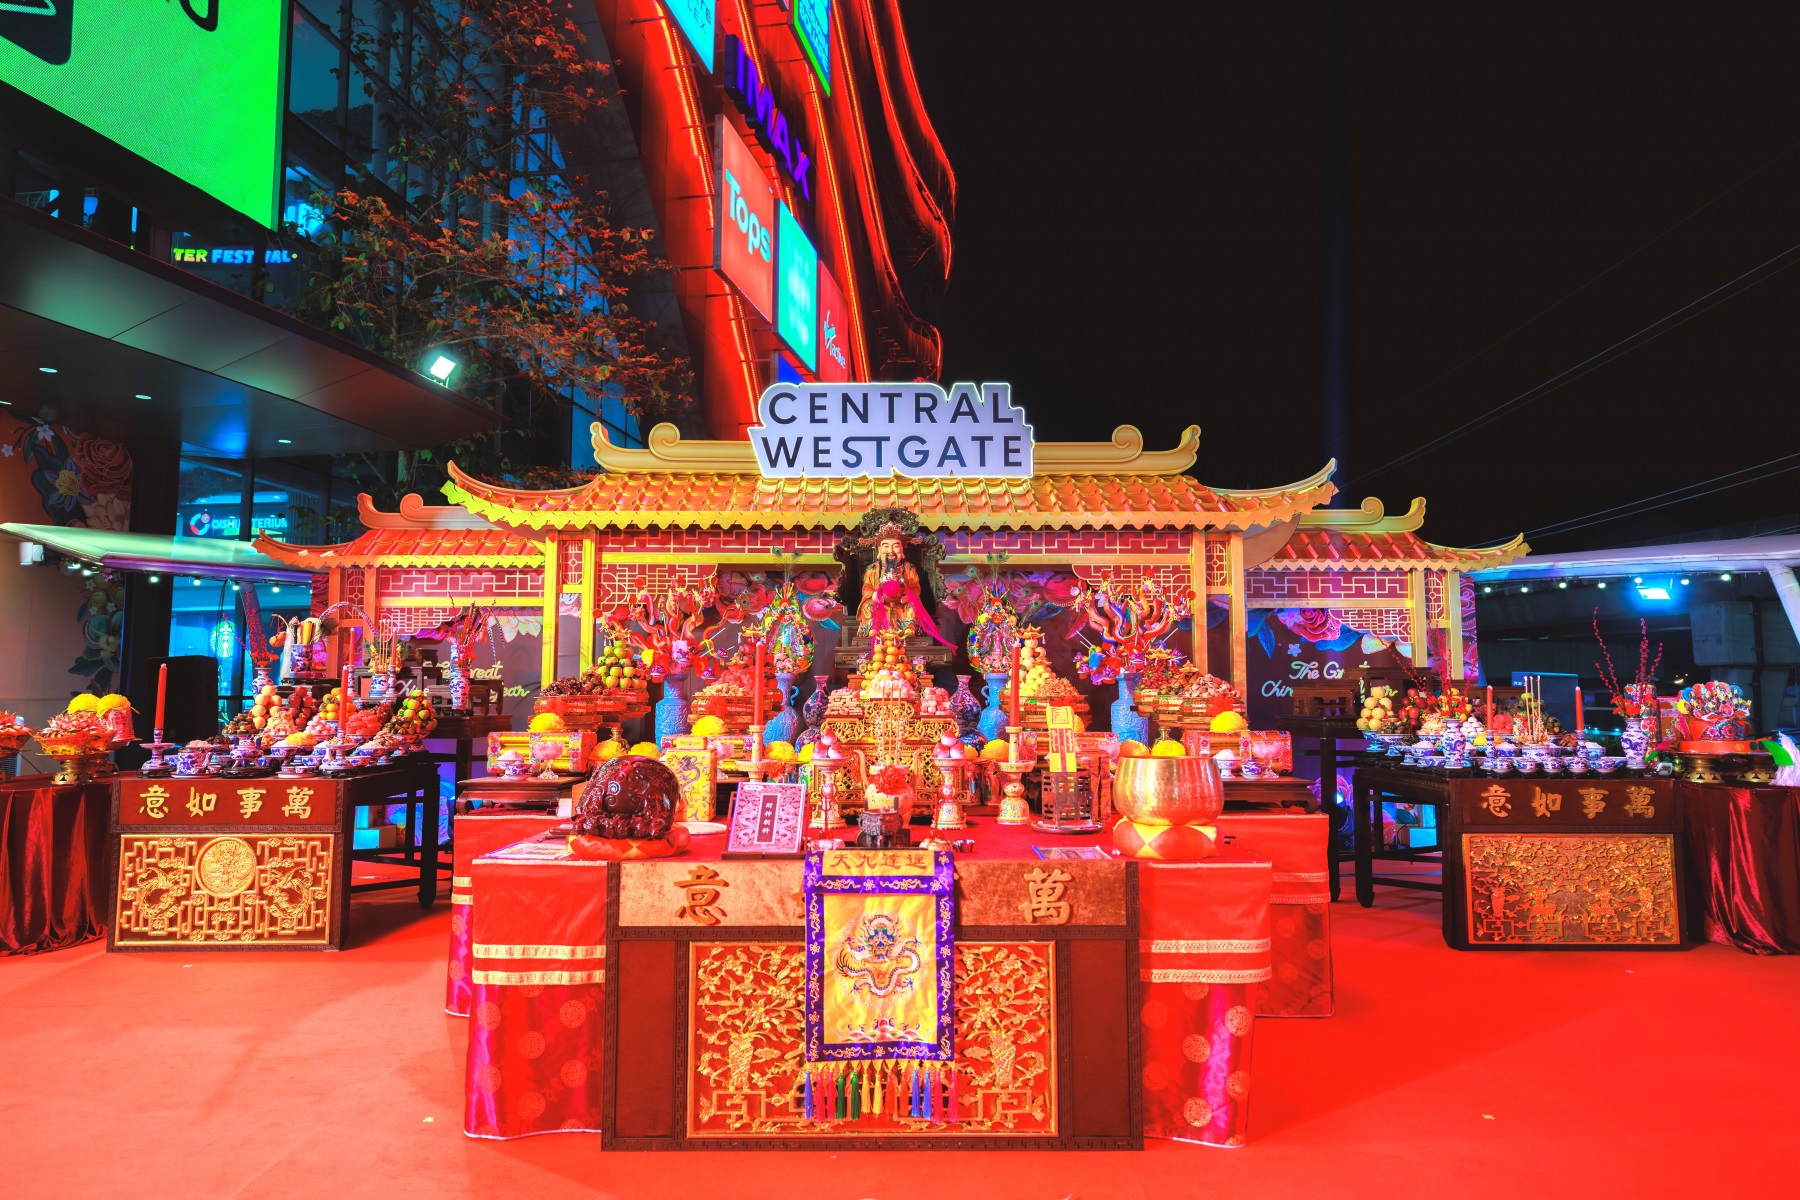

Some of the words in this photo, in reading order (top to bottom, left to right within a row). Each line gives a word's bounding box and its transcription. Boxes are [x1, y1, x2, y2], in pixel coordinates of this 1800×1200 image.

[736, 37, 811, 202] IMAX
[725, 168, 771, 262] Tops
[173, 248, 208, 262] TER
[211, 249, 291, 264] FESTAL
[768, 392, 1014, 424] CENTRAL
[761, 435, 1022, 468] WESTGATE
[469, 660, 504, 680] reat
[1288, 660, 1320, 680] The
